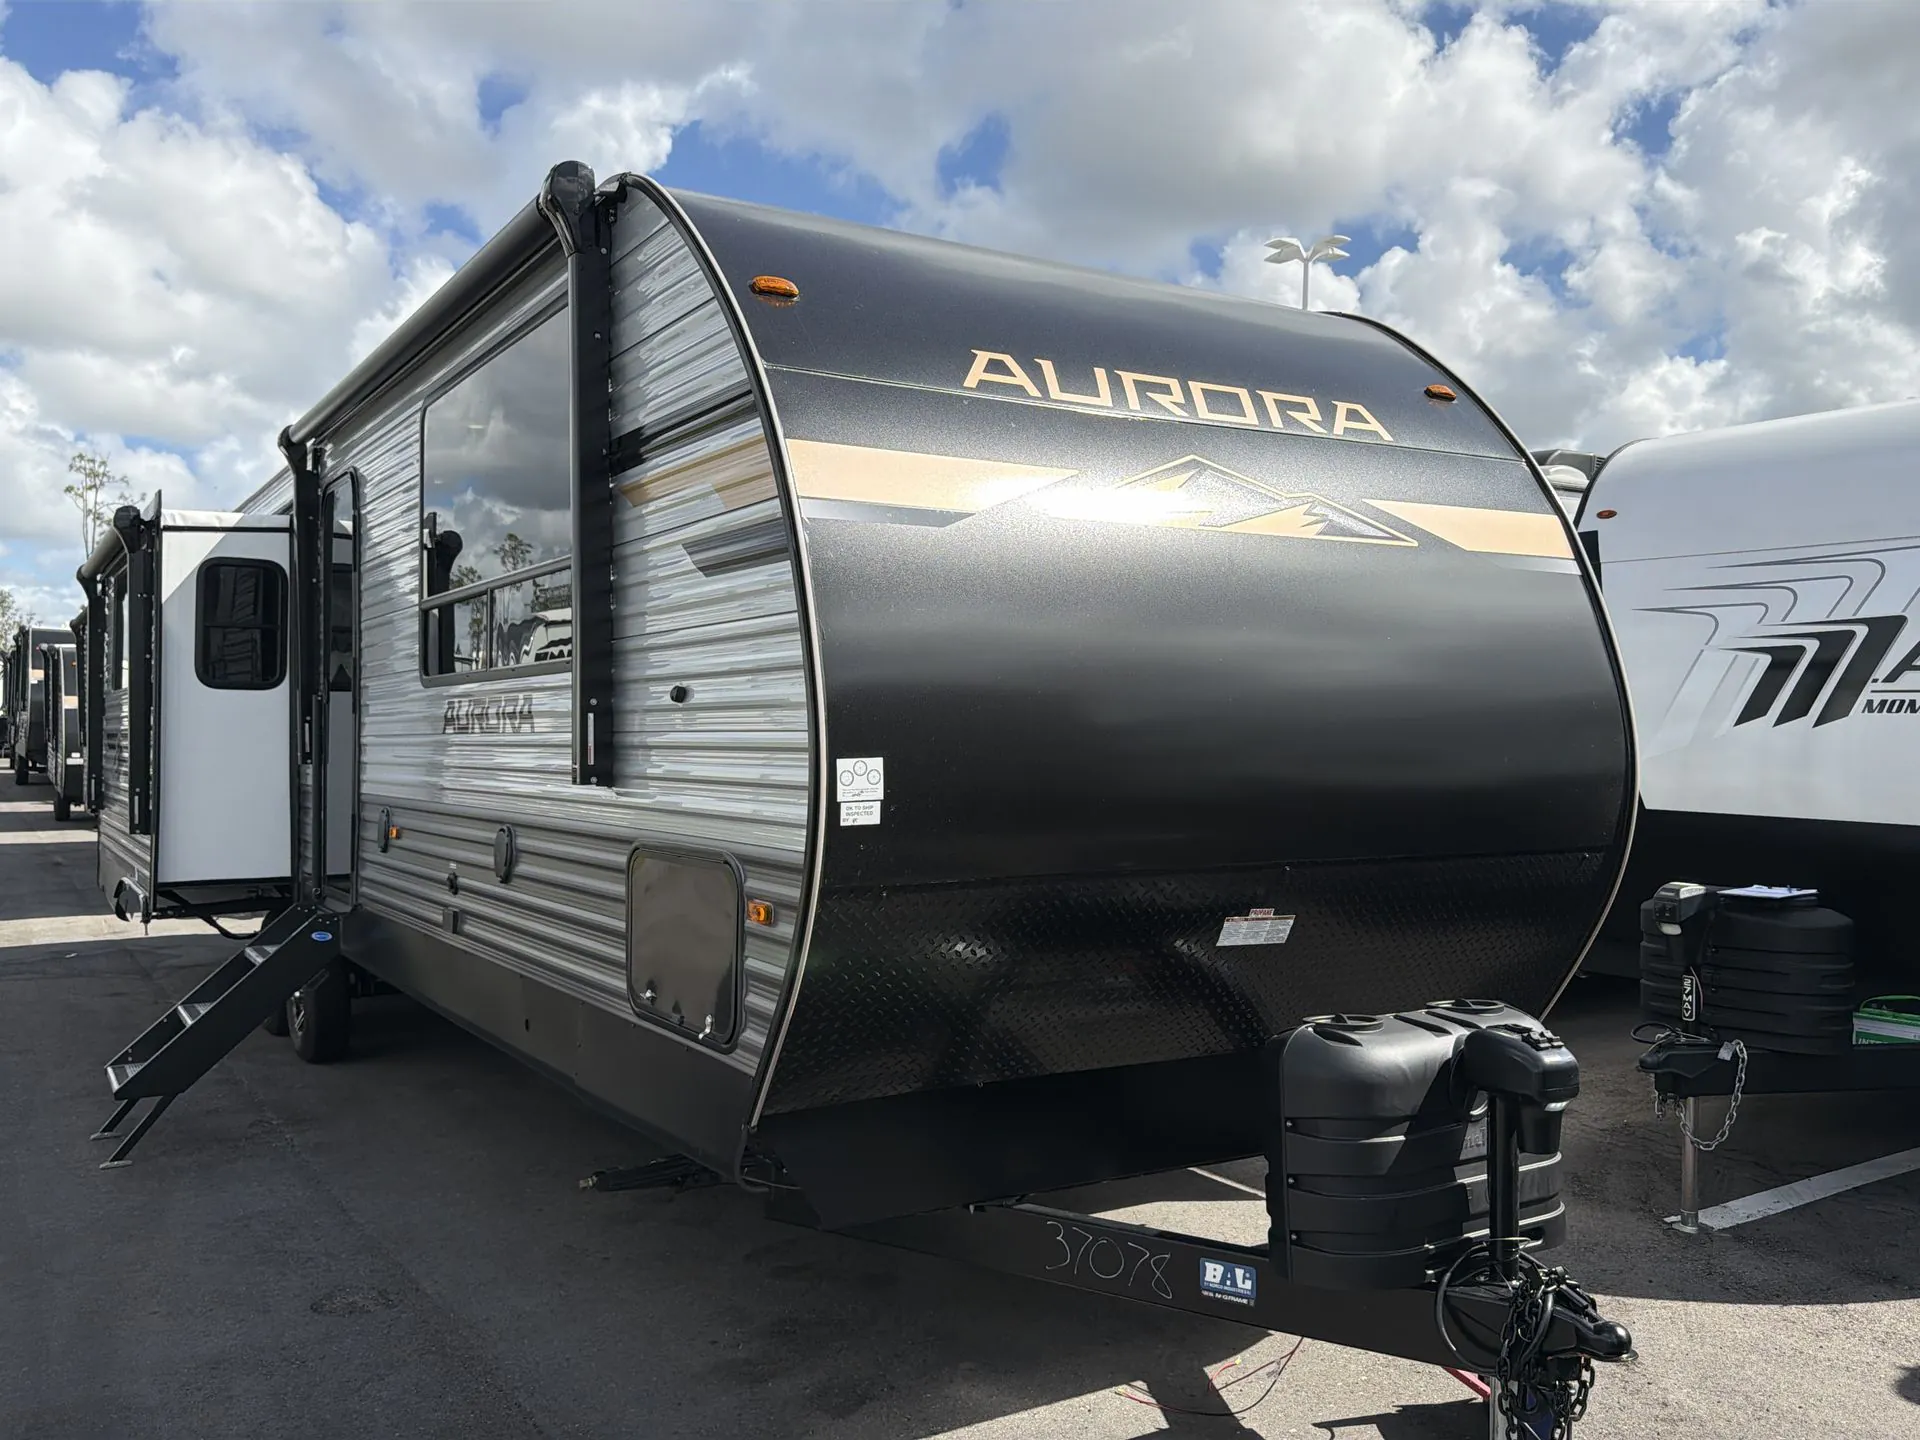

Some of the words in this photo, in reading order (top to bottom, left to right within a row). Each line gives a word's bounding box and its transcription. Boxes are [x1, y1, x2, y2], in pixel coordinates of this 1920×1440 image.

[963, 349, 1394, 442] AURORA
[442, 695, 535, 734] AURORA
[1683, 978, 1692, 1017] 27MAV
[1046, 1221, 1172, 1299] 37078
